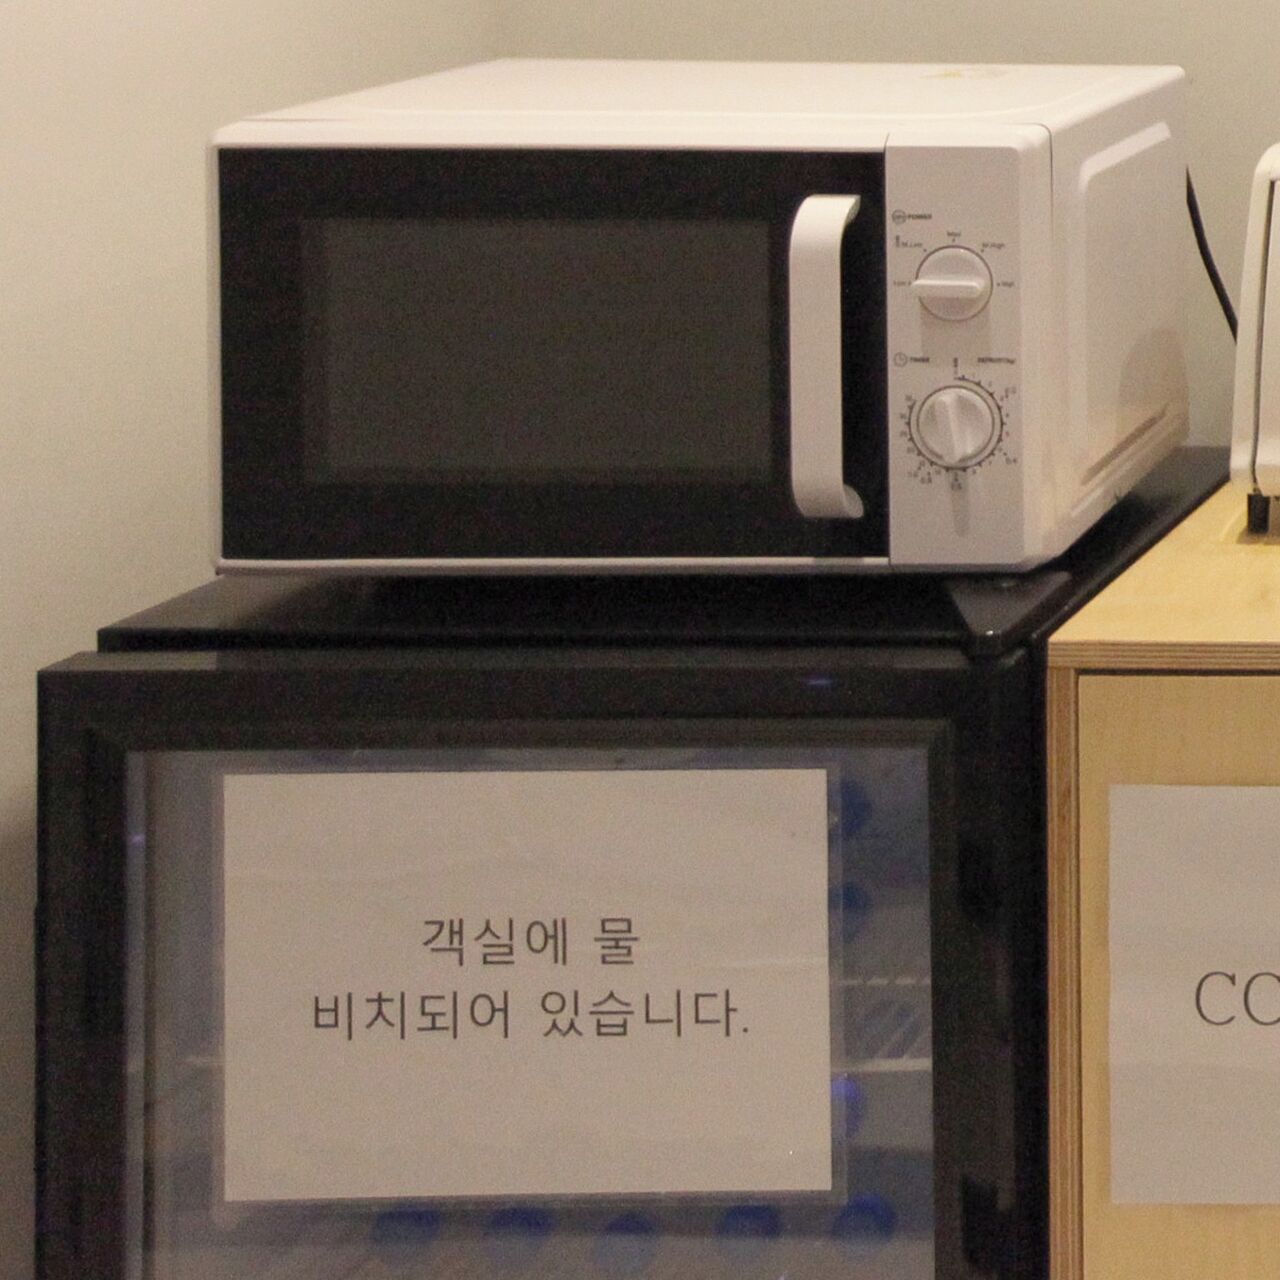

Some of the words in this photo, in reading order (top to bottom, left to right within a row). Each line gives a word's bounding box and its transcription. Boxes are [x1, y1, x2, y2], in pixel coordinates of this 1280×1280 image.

[421, 916, 569, 968] 객실에
[592, 916, 641, 966] 물
[312, 989, 510, 1041] 비치되어
[539, 987, 750, 1039] 있습니다.
